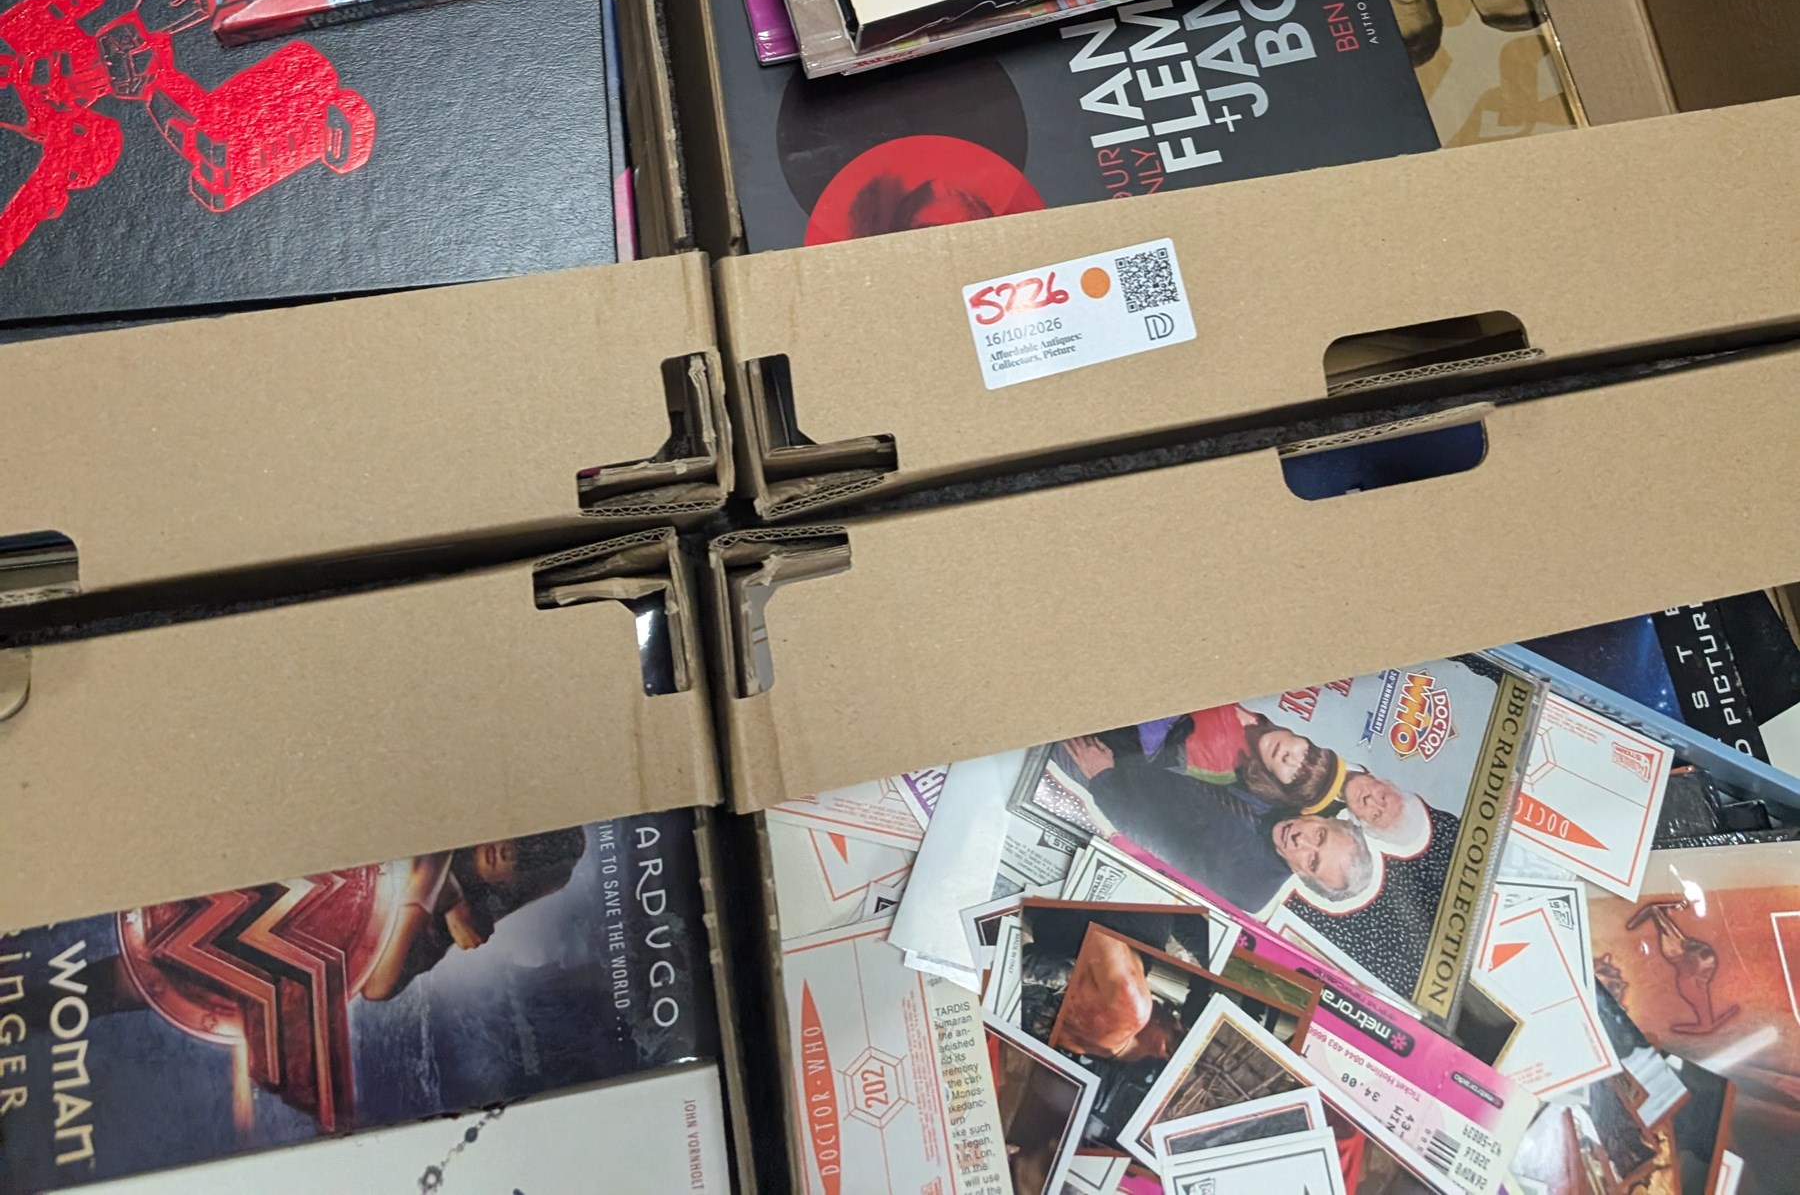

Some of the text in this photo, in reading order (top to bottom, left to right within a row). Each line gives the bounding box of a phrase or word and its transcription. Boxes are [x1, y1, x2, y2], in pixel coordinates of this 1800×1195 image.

[1322, 1, 1361, 54] BEN
[1058, 17, 1151, 149] IAN
[969, 271, 1070, 325] S226
[984, 316, 1063, 348] 16/10/2026
[988, 342, 1039, 363] Affordable
[1042, 343, 1078, 360] Picture
[1374, 685, 1395, 733] ANNIVERSARY
[1389, 672, 1436, 755] WHO
[1420, 692, 1448, 757] DOCTOR
[1428, 683, 1530, 1008] BBC RADIO COLLECTION
[598, 819, 632, 1010] IME TO SAVE THE WORLD
[634, 826, 679, 1028] ARDUGO
[934, 1001, 971, 1017] TARDIS
[1321, 988, 1392, 1040] metrora
[1326, 1039, 1344, 1054] 493
[1344, 1050, 1366, 1068] 0844
[860, 1065, 890, 1109] 202
[1340, 1071, 1382, 1103] 34.00
[1365, 1061, 1395, 1086] Hotline
[1393, 1079, 1422, 1102] Ticket
[683, 1099, 699, 1129] JOHN
[803, 1026, 841, 1176] DOCTOR WHO
[969, 1123, 991, 1135] such
[964, 1173, 1000, 1188] will use
